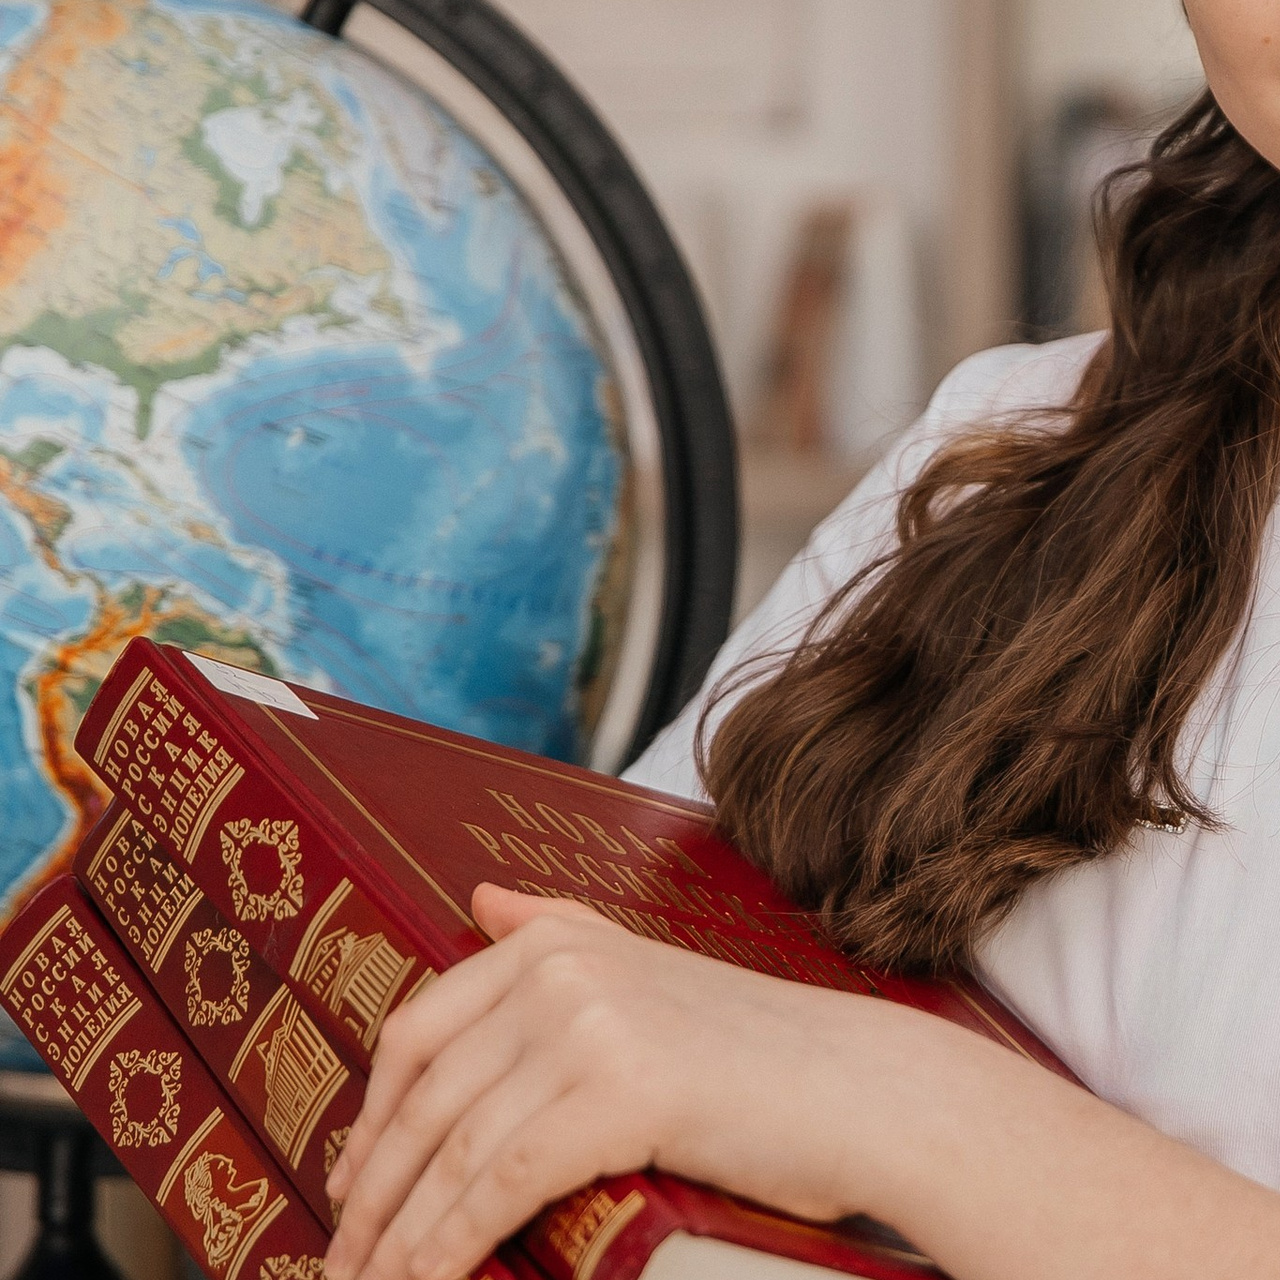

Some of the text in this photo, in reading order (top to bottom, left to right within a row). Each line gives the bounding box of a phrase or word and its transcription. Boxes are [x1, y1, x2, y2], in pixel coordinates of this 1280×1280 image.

[105, 678, 169, 783] НОВАЯ
[121, 694, 185, 801] РОССИЙ
[138, 712, 202, 816] СКАЯ
[152, 729, 218, 833] ЭНЦИК
[168, 745, 235, 852] ЛОПЕДИЯ
[93, 819, 145, 896] НОВА
[104, 830, 158, 913] РОССИ
[484, 787, 713, 880] НОВАЯ
[117, 856, 163, 927] СКА
[127, 862, 179, 944] ЭНЦИ
[140, 872, 196, 962] ЛОПЕДИ
[516, 878, 890, 998] ИКЛОПЕДИЯ
[7, 916, 84, 1011] НОВАЯ
[21, 931, 96, 1029] РОССИЙ
[35, 948, 108, 1043] СКАЯ
[46, 965, 121, 1061] ЭНЦИК
[60, 981, 134, 1080] ЛОПЕДИЯ
